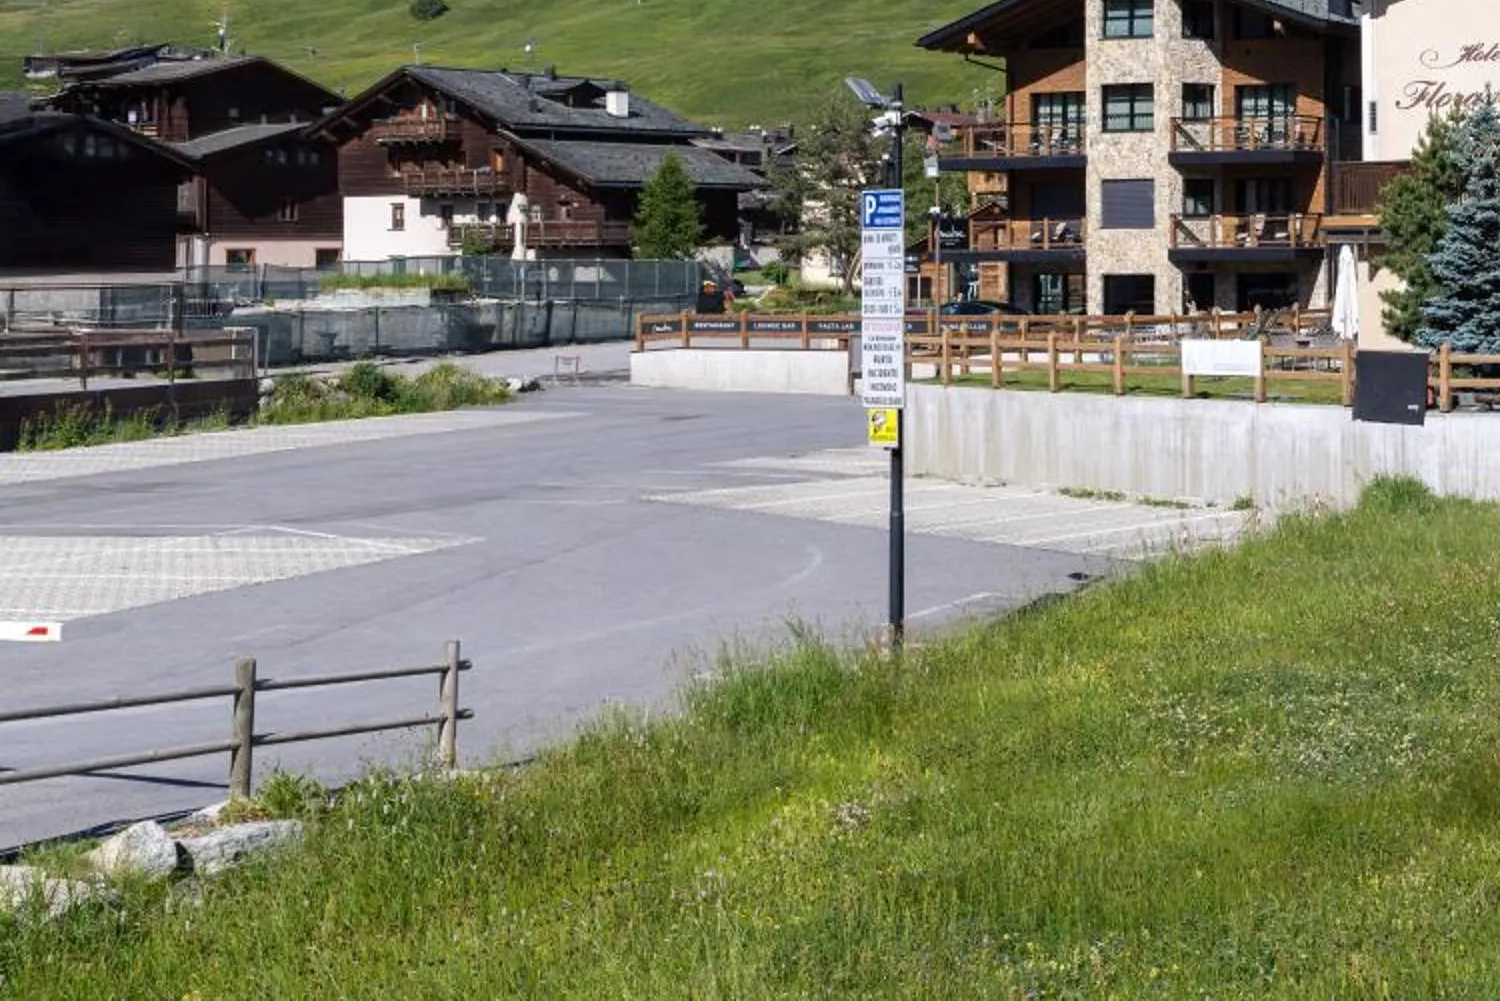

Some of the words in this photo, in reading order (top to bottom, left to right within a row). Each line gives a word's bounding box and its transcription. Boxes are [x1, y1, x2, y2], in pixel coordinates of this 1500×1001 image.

[1395, 80, 1486, 110] Flora
[865, 194, 877, 225] P
[694, 321, 735, 329] RESTAURANT
[781, 321, 796, 329] BAR
